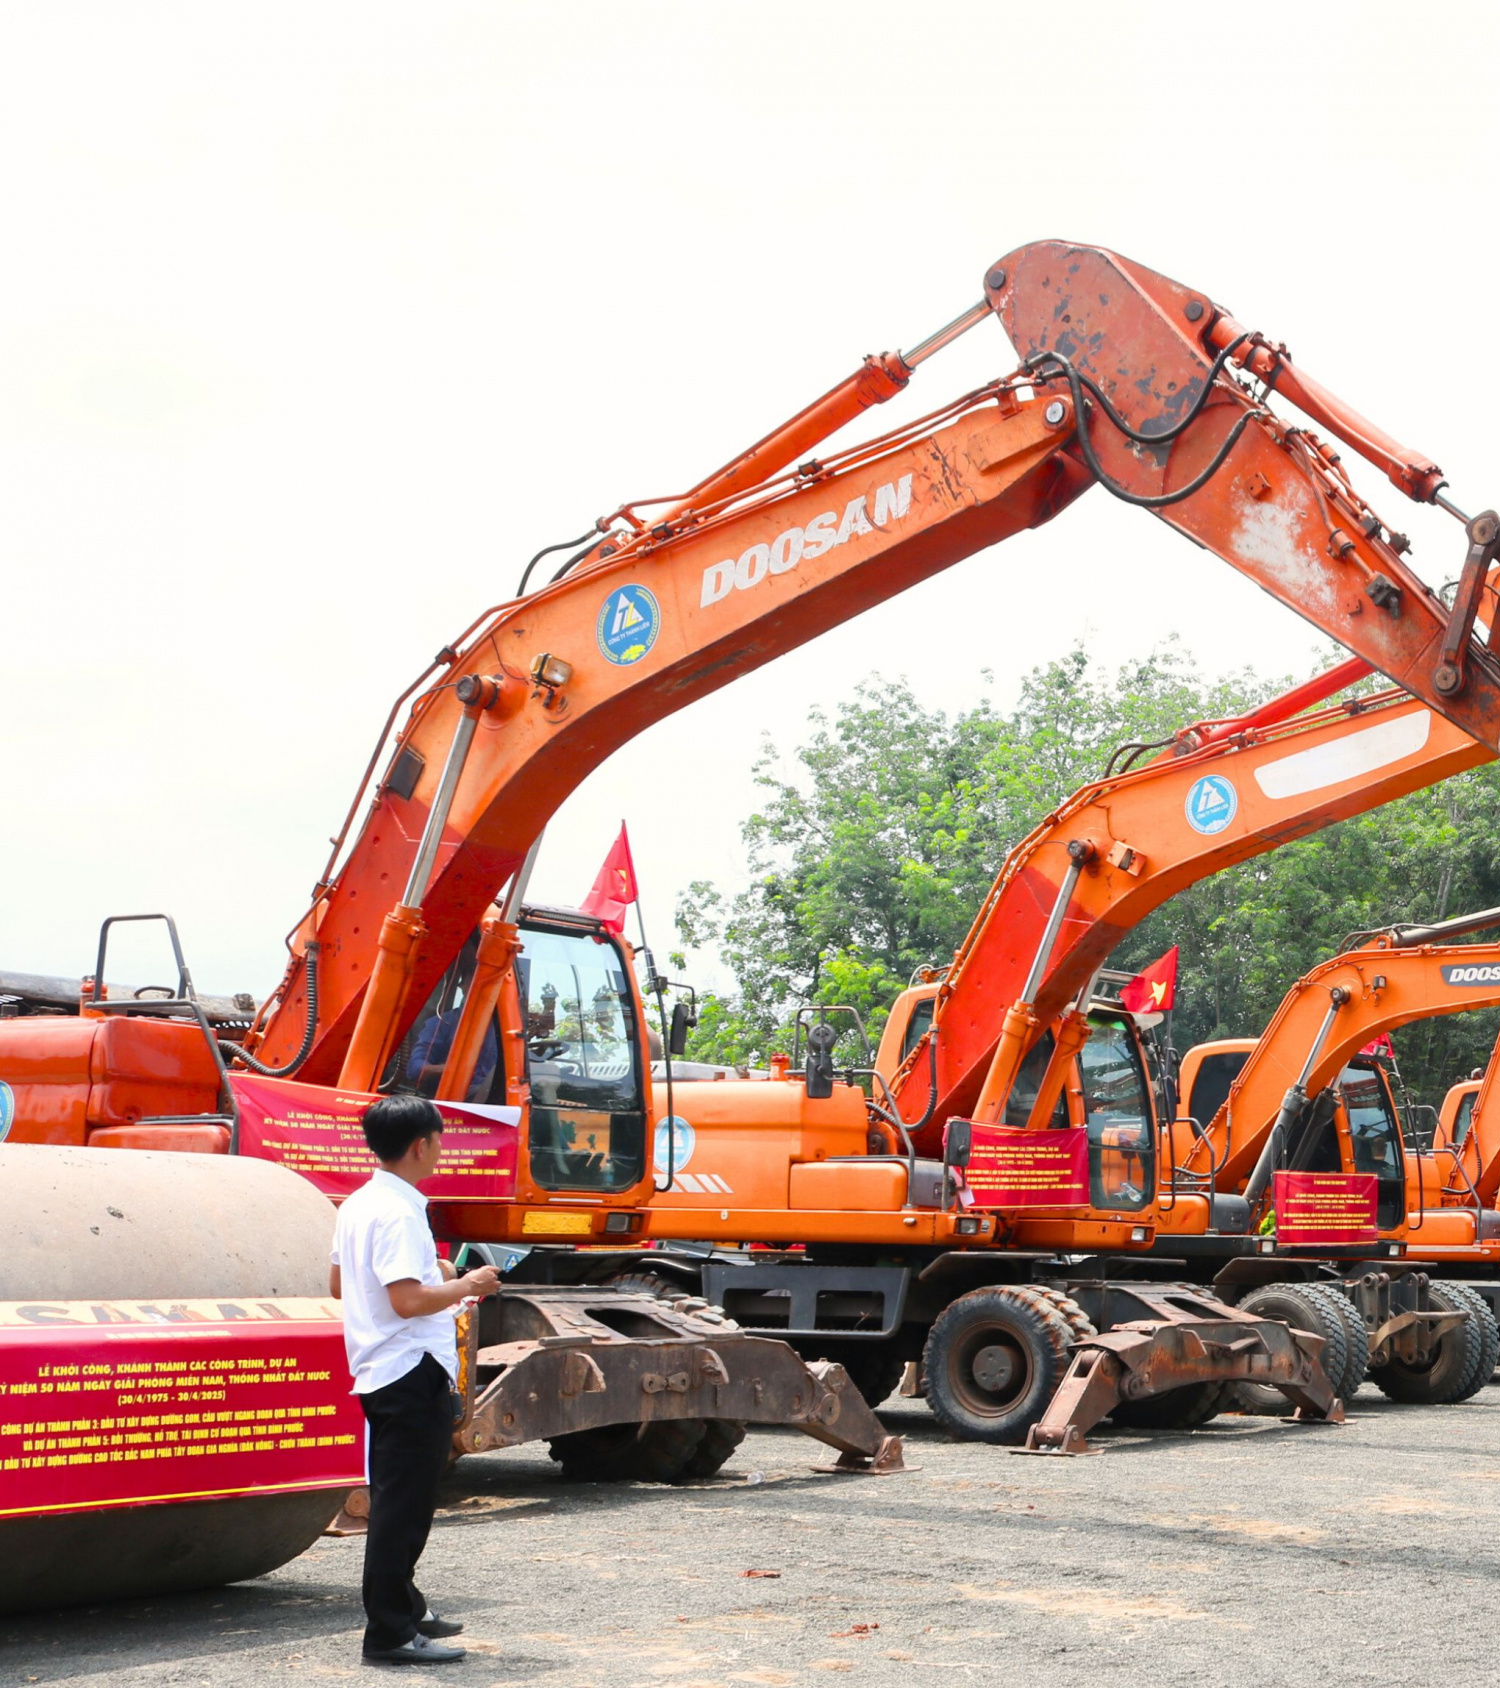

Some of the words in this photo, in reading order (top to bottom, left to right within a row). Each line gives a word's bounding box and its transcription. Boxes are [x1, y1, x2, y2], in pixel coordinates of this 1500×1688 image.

[700, 473, 913, 608] DOOSAN
[118, 1394, 168, 1406] (30/4/1975
[178, 1390, 226, 1403] 30/4/2025)
